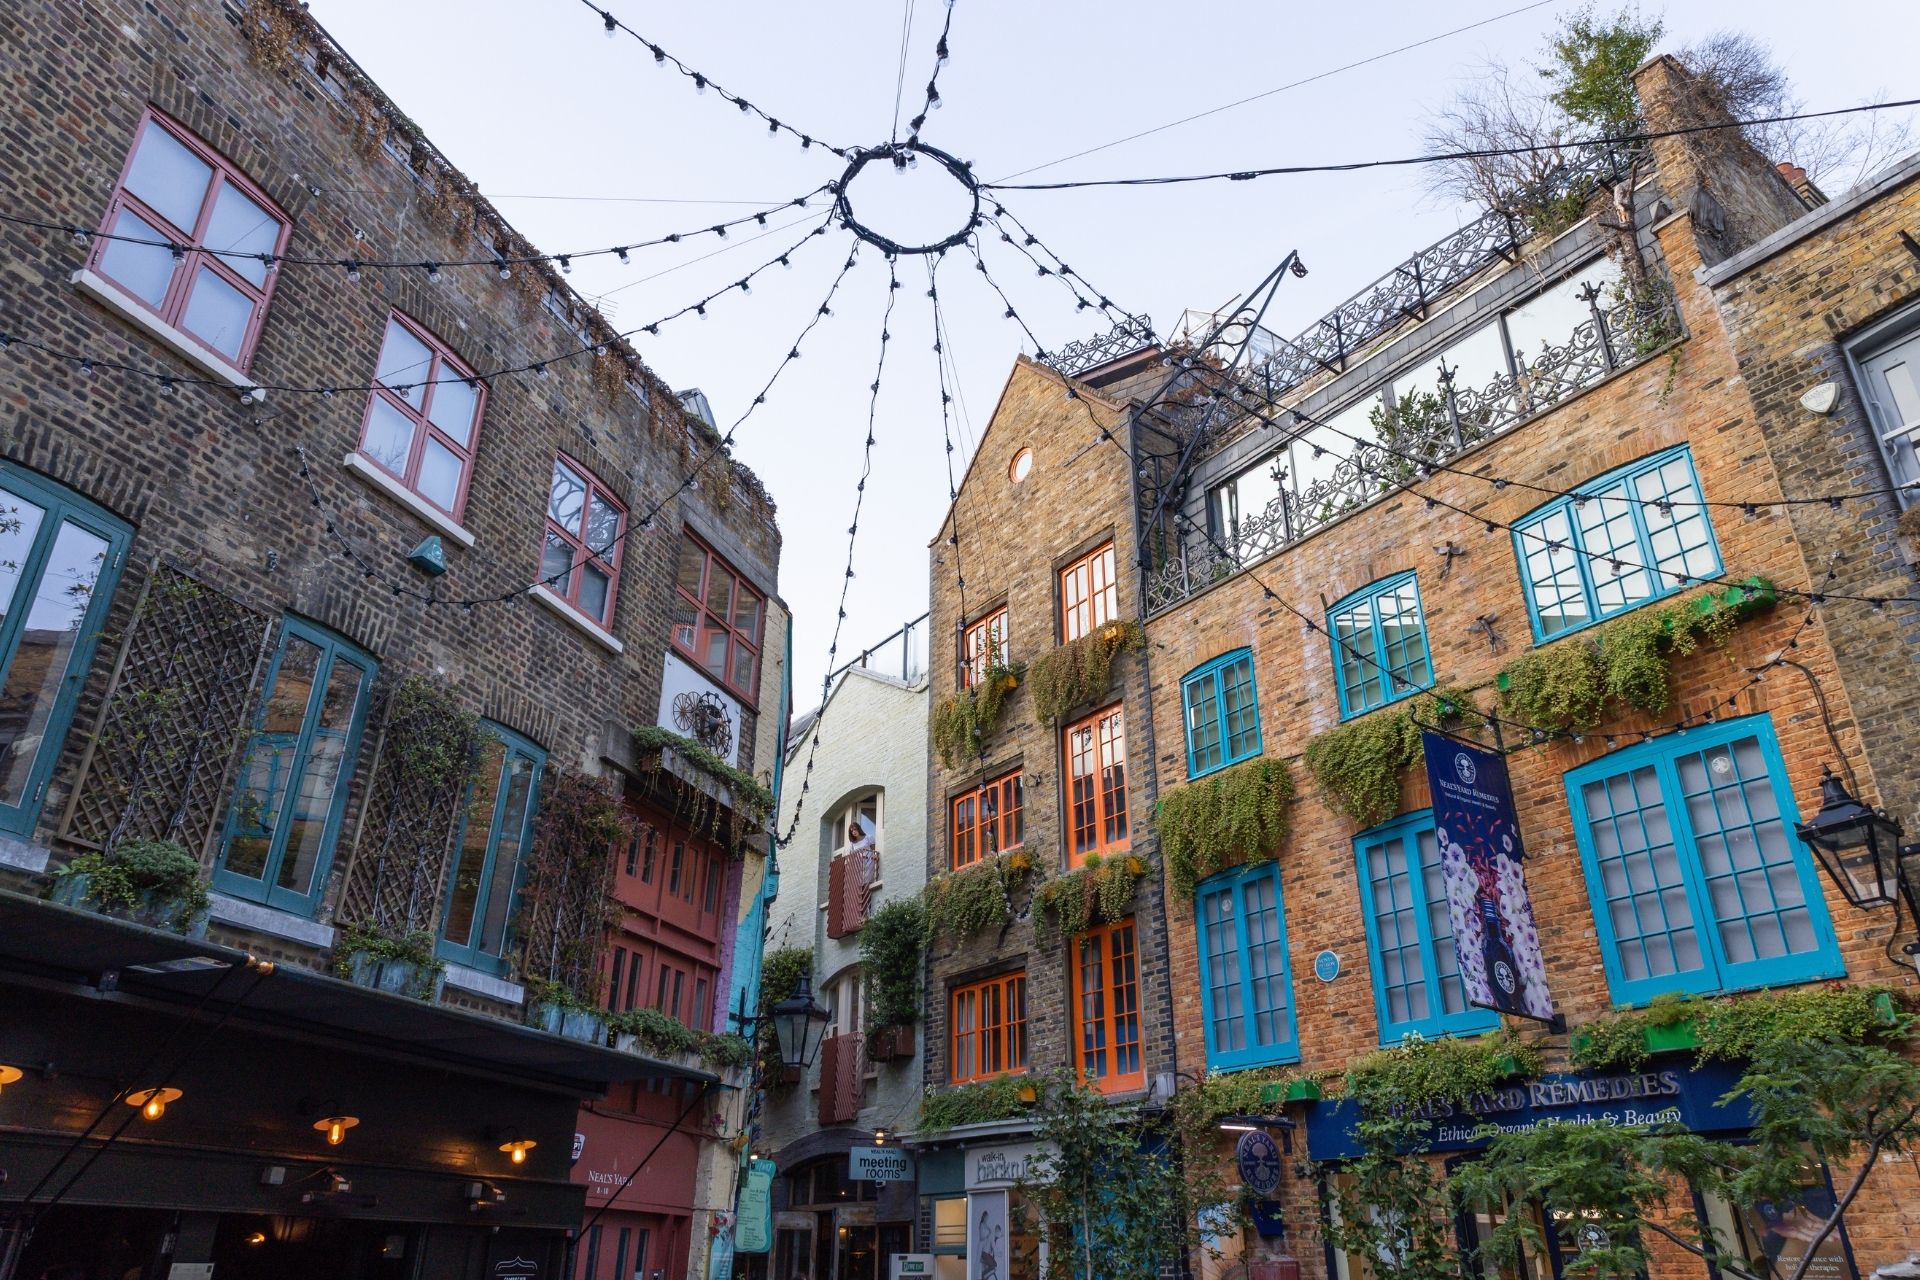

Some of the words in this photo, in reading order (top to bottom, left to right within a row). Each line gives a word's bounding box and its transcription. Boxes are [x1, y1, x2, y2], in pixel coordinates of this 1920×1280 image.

[1473, 789, 1500, 803] REMEDIES
[1467, 1088, 1526, 1113] ARD
[1527, 1071, 1680, 1108] REMEDIES
[1438, 1124, 1482, 1142] Ethica
[1603, 1112, 1619, 1128] &
[1624, 1109, 1681, 1126] Beauty
[860, 1156, 907, 1171] meeting
[588, 1170, 613, 1183] NEAL'S
[865, 1169, 900, 1178] rooms
